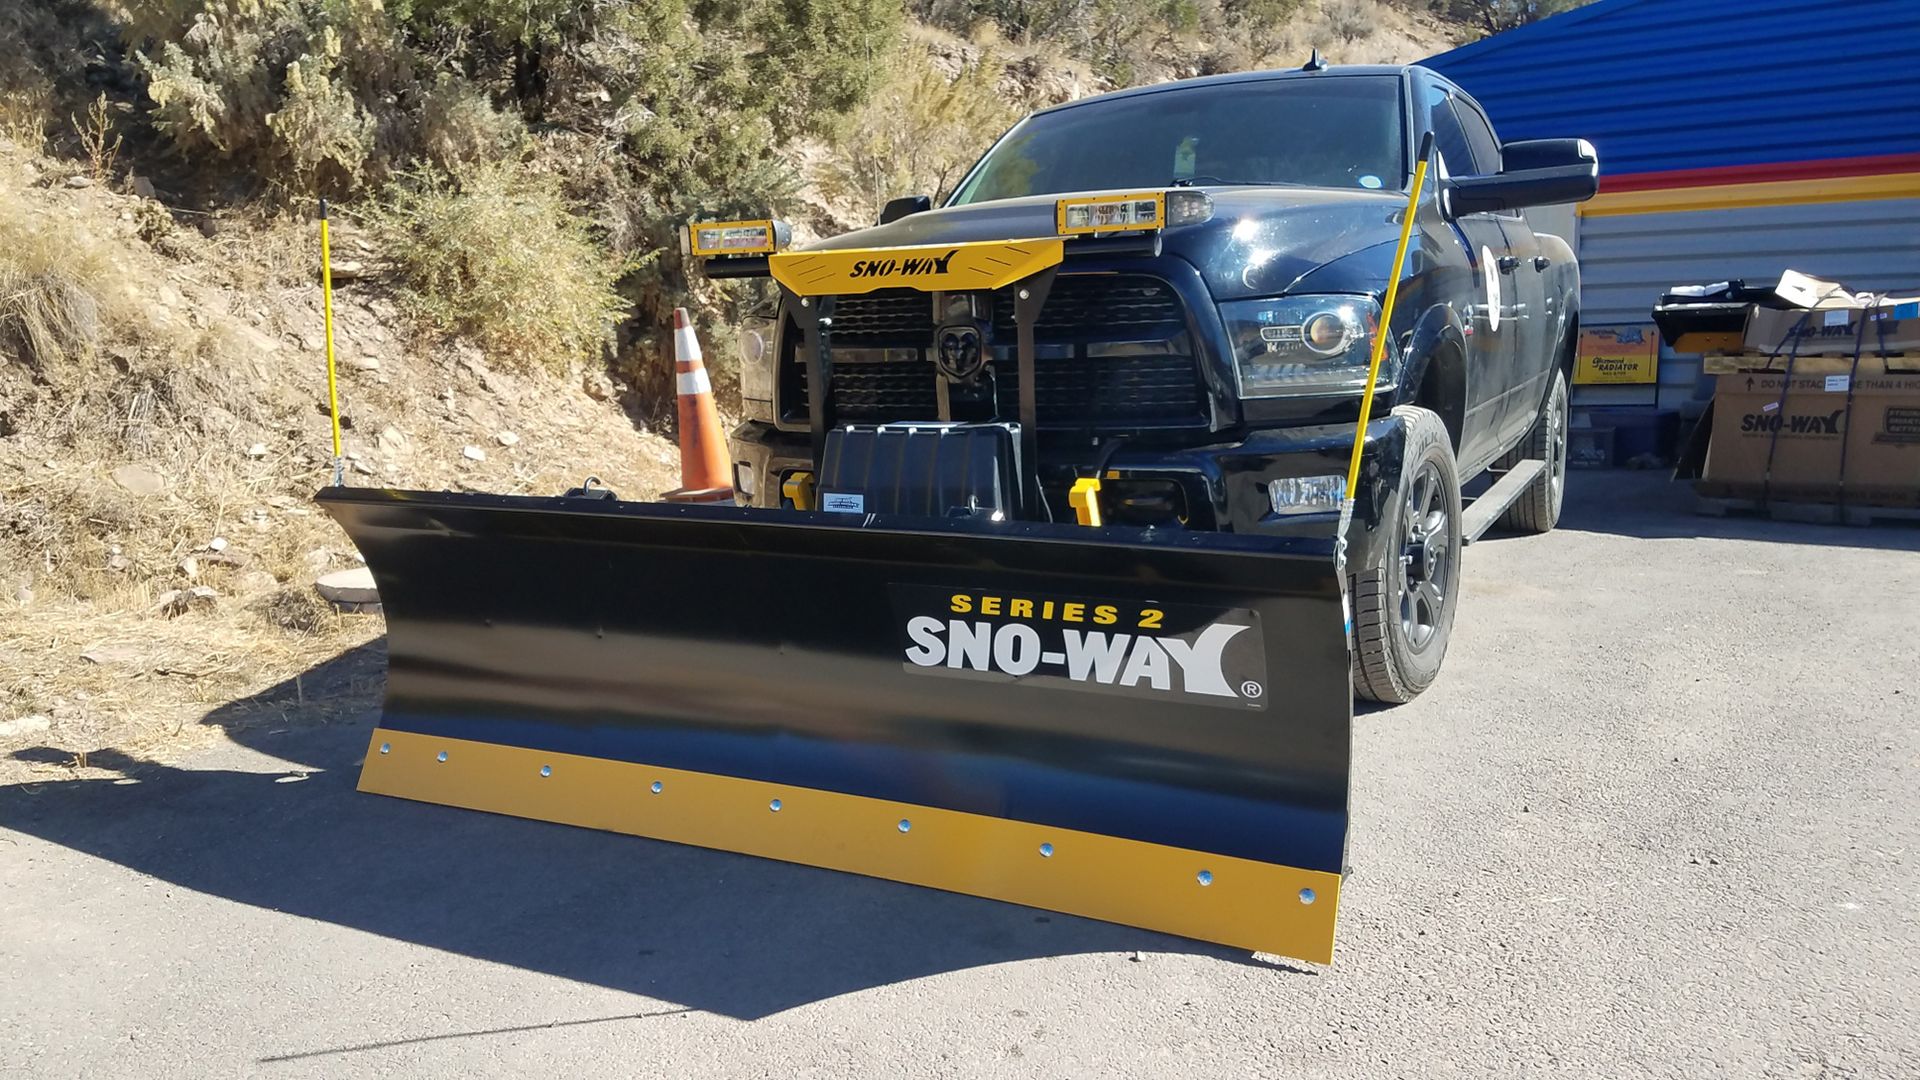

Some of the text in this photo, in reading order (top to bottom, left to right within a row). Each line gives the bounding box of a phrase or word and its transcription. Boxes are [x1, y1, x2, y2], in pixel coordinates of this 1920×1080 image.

[849, 249, 960, 278] SNO-WAY
[1598, 363, 1639, 372] RADIATOR
[1760, 379, 1776, 389] DO
[1798, 379, 1825, 390] STAC
[1865, 379, 1894, 390] THAN
[1895, 379, 1902, 390] 4
[1740, 409, 1845, 434] SNO-WAY
[949, 594, 1165, 630] SERIES 2
[905, 615, 1251, 698] SNO-WAY
